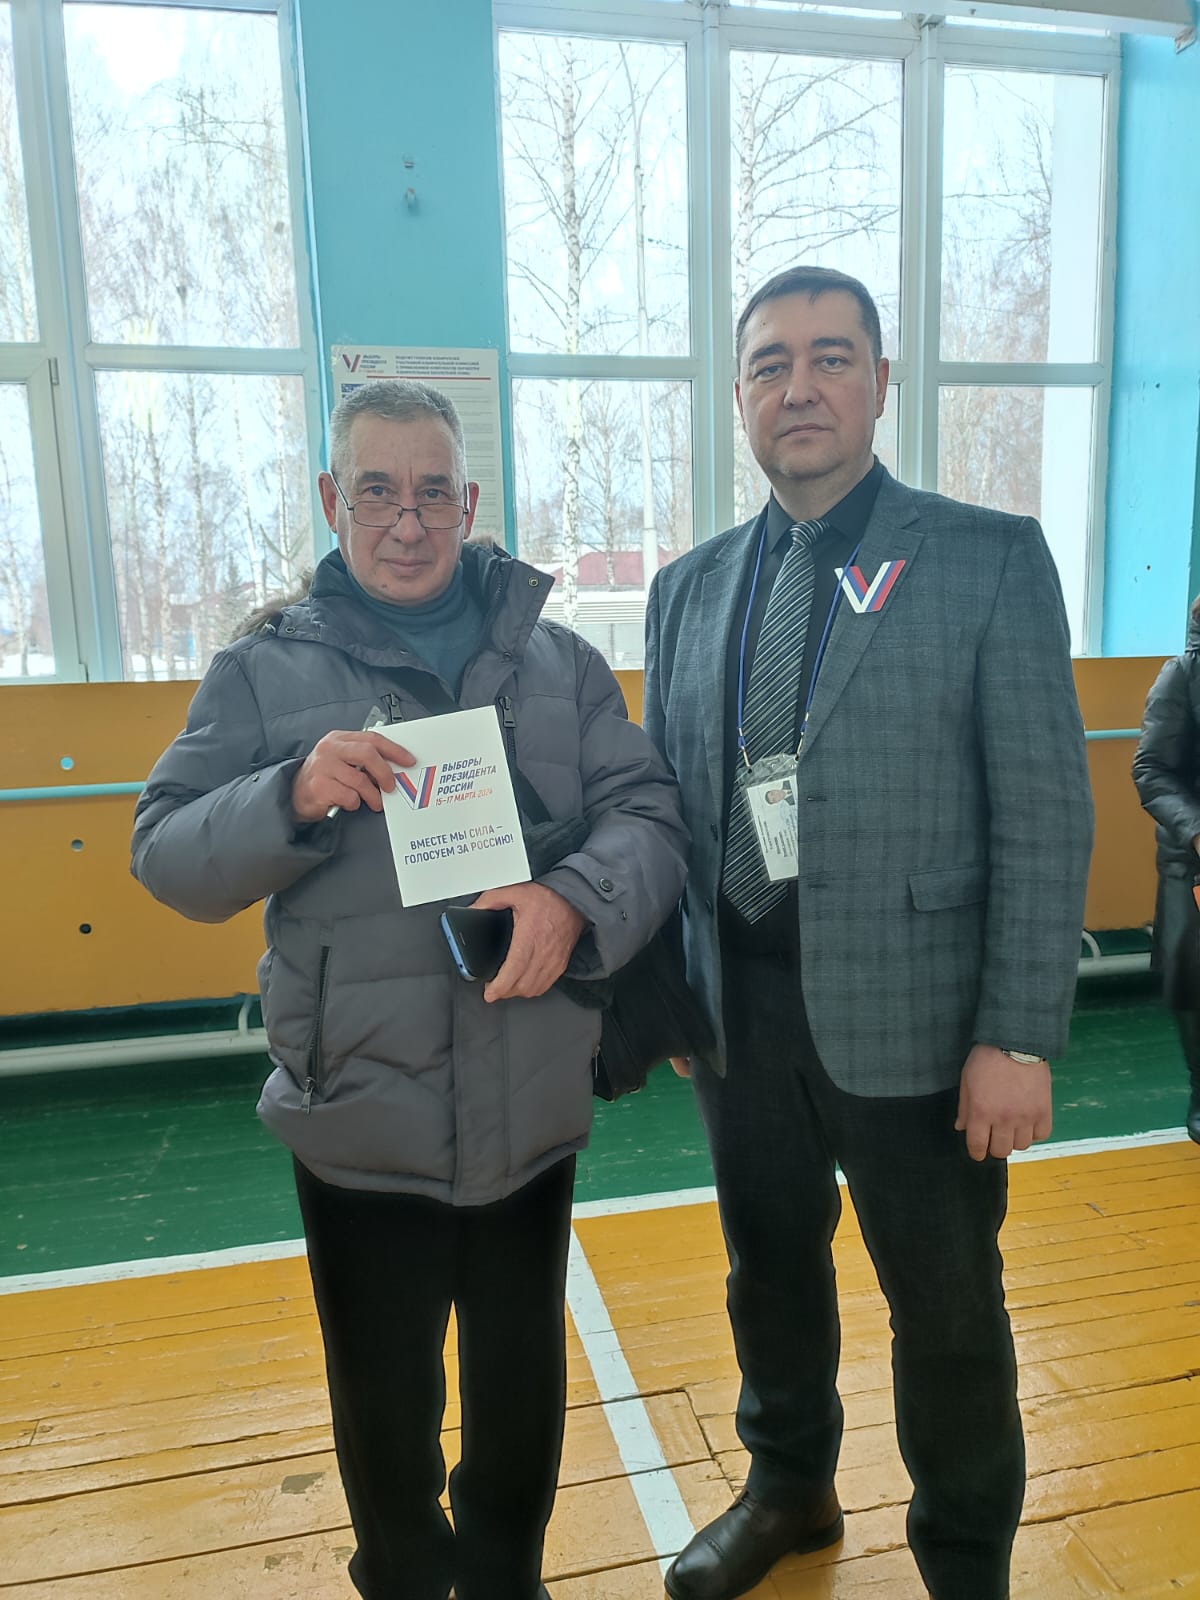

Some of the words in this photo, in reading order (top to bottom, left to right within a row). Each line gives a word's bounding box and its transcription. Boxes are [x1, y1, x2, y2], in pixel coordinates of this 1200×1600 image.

[441, 757, 482, 773] ВЫБОРЫ
[439, 765, 497, 784] ПРЕЗИДЕНТА
[437, 781, 474, 795] РОССИИ
[454, 791, 476, 802] МАРТА
[410, 834, 448, 850] ВМЕСТЕ
[450, 830, 467, 843] МЫ
[469, 825, 495, 838] СИЛА
[404, 846, 455, 865] ГОЛОСУЕМ
[456, 844, 470, 854] ЗА
[471, 833, 514, 851] РОССИЮ!
